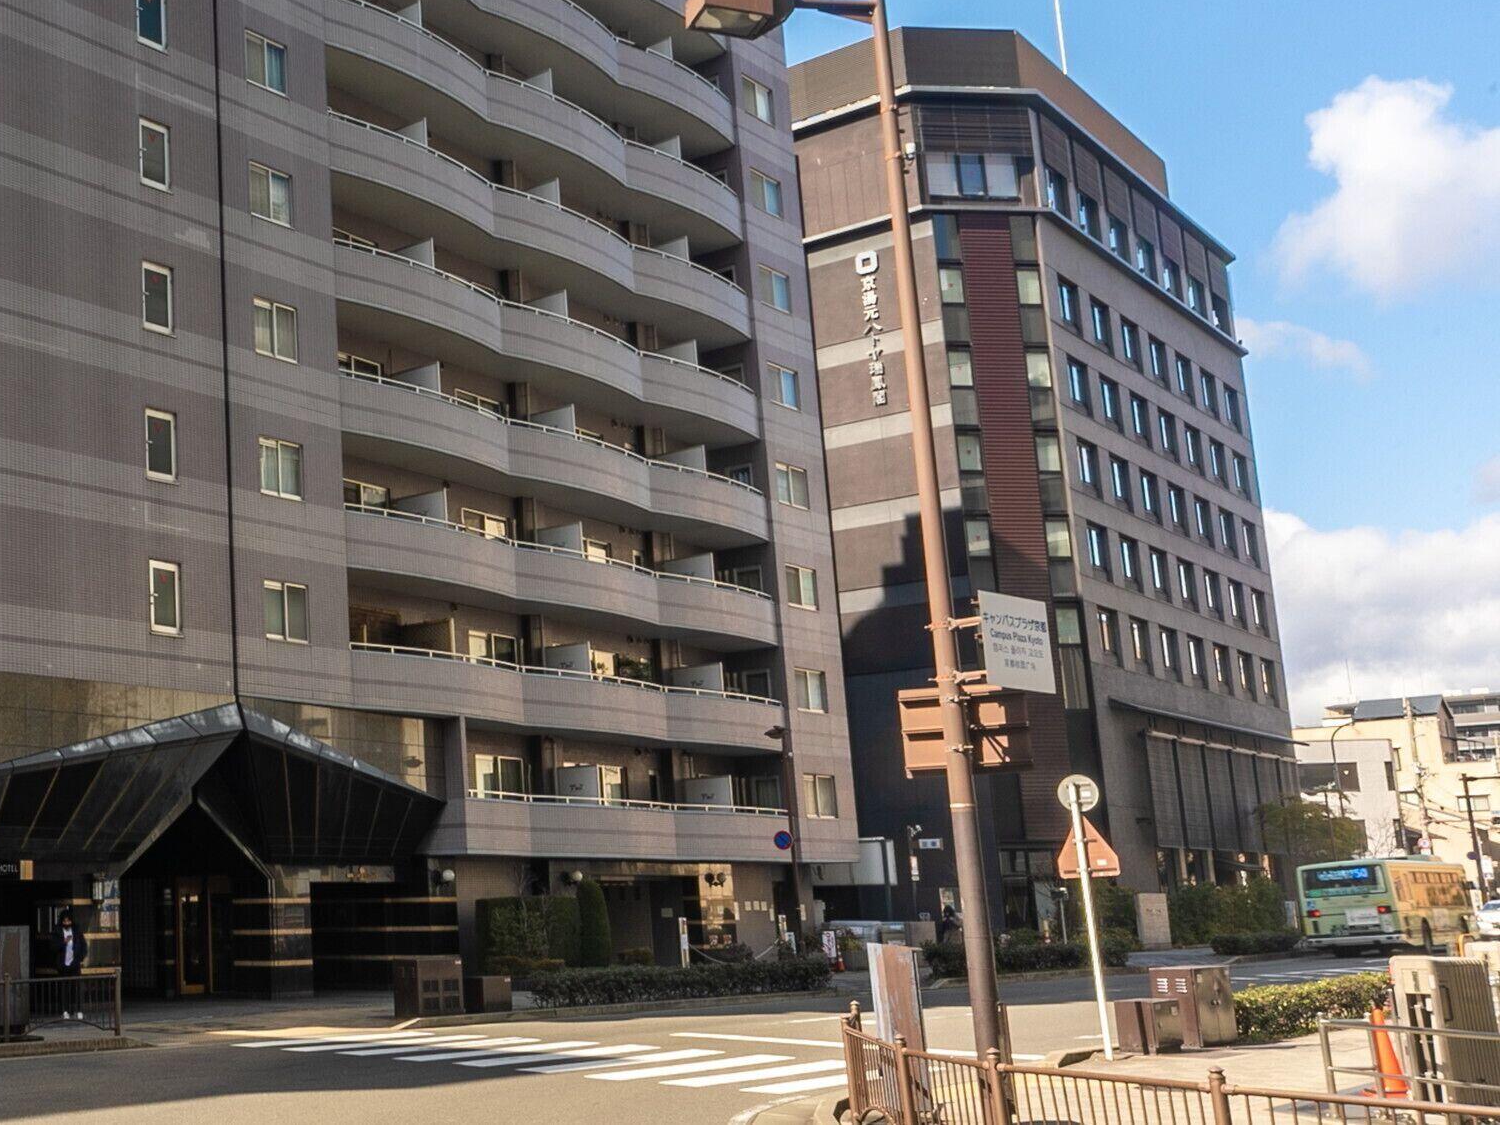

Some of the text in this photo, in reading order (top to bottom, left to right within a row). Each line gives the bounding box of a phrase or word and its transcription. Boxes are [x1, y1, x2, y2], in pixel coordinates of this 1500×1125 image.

[983, 612, 1047, 633] キャンパスプラザ京都
[990, 627, 1044, 646] Campus Plaza Kyoto
